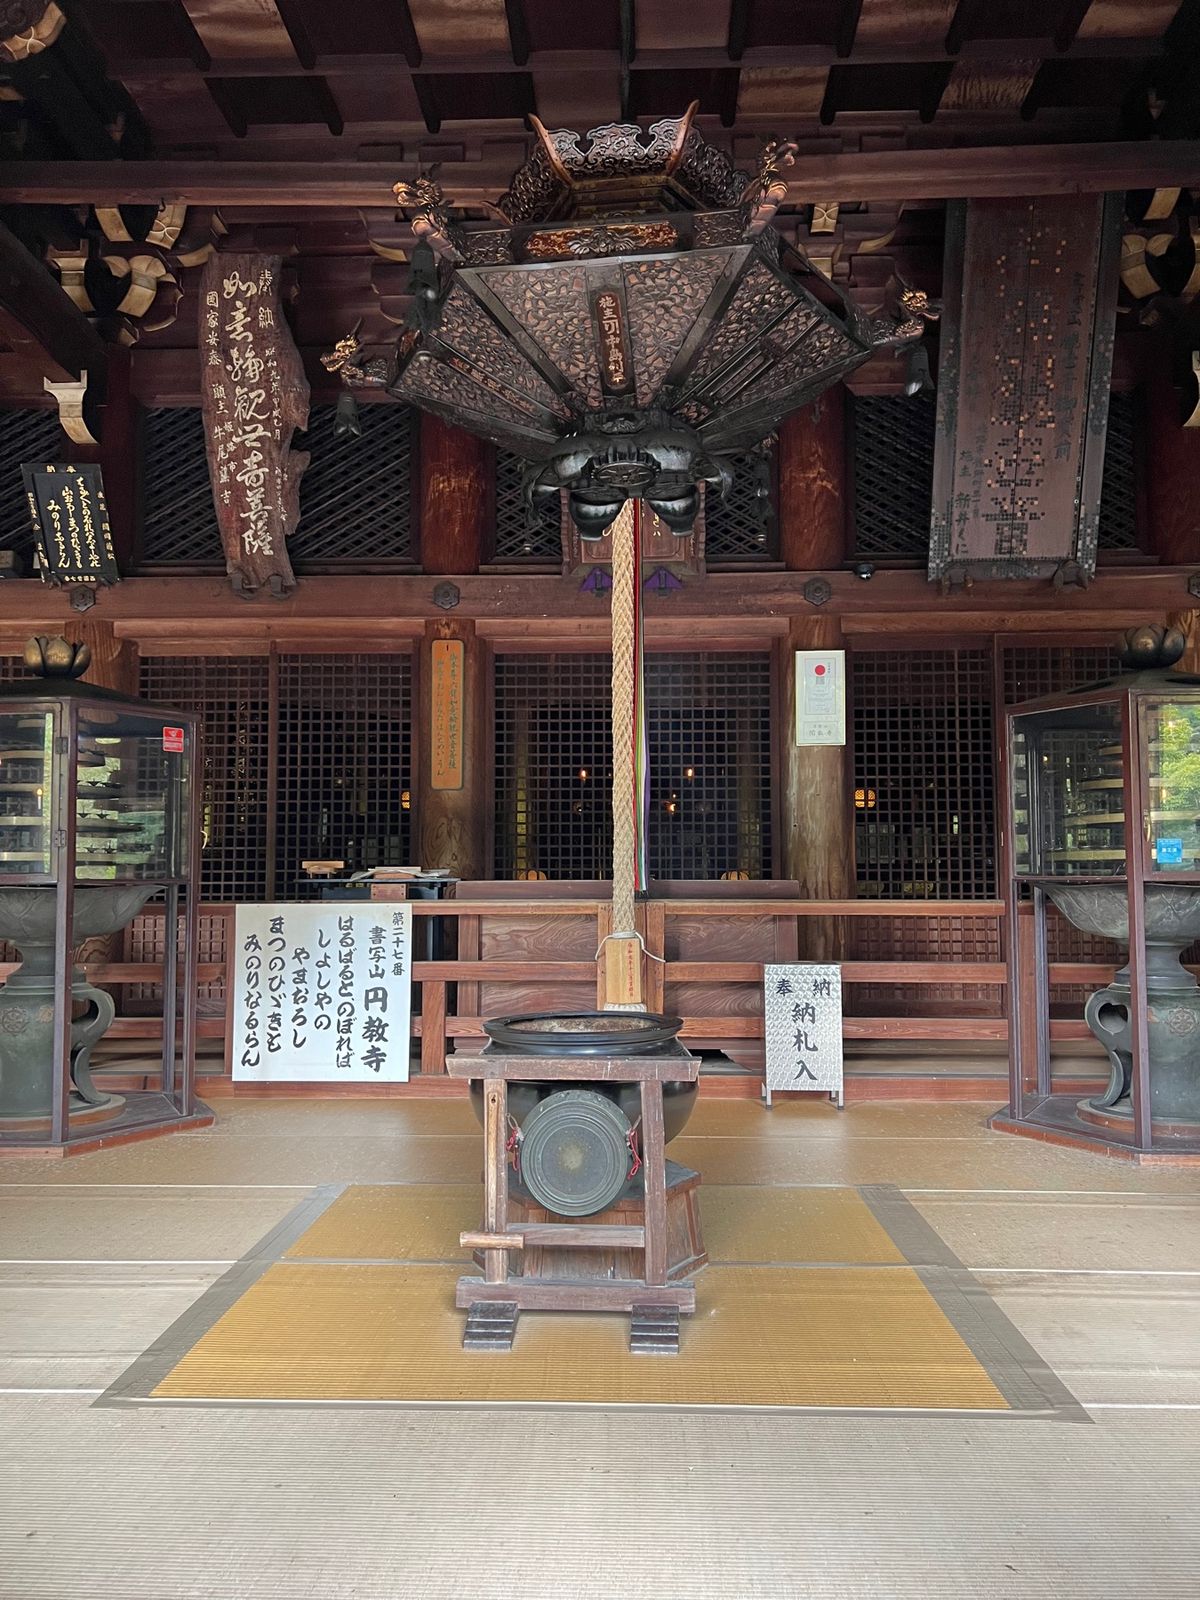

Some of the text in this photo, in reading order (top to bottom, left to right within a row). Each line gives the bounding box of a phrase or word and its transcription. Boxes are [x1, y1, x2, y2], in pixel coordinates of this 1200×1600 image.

[206, 291, 222, 366] 國家安泰
[391, 912, 406, 976] 第二十七番
[241, 934, 263, 1067] みのりなるらん
[291, 946, 311, 1049] やまおろし
[791, 1002, 819, 1081] 納札入
